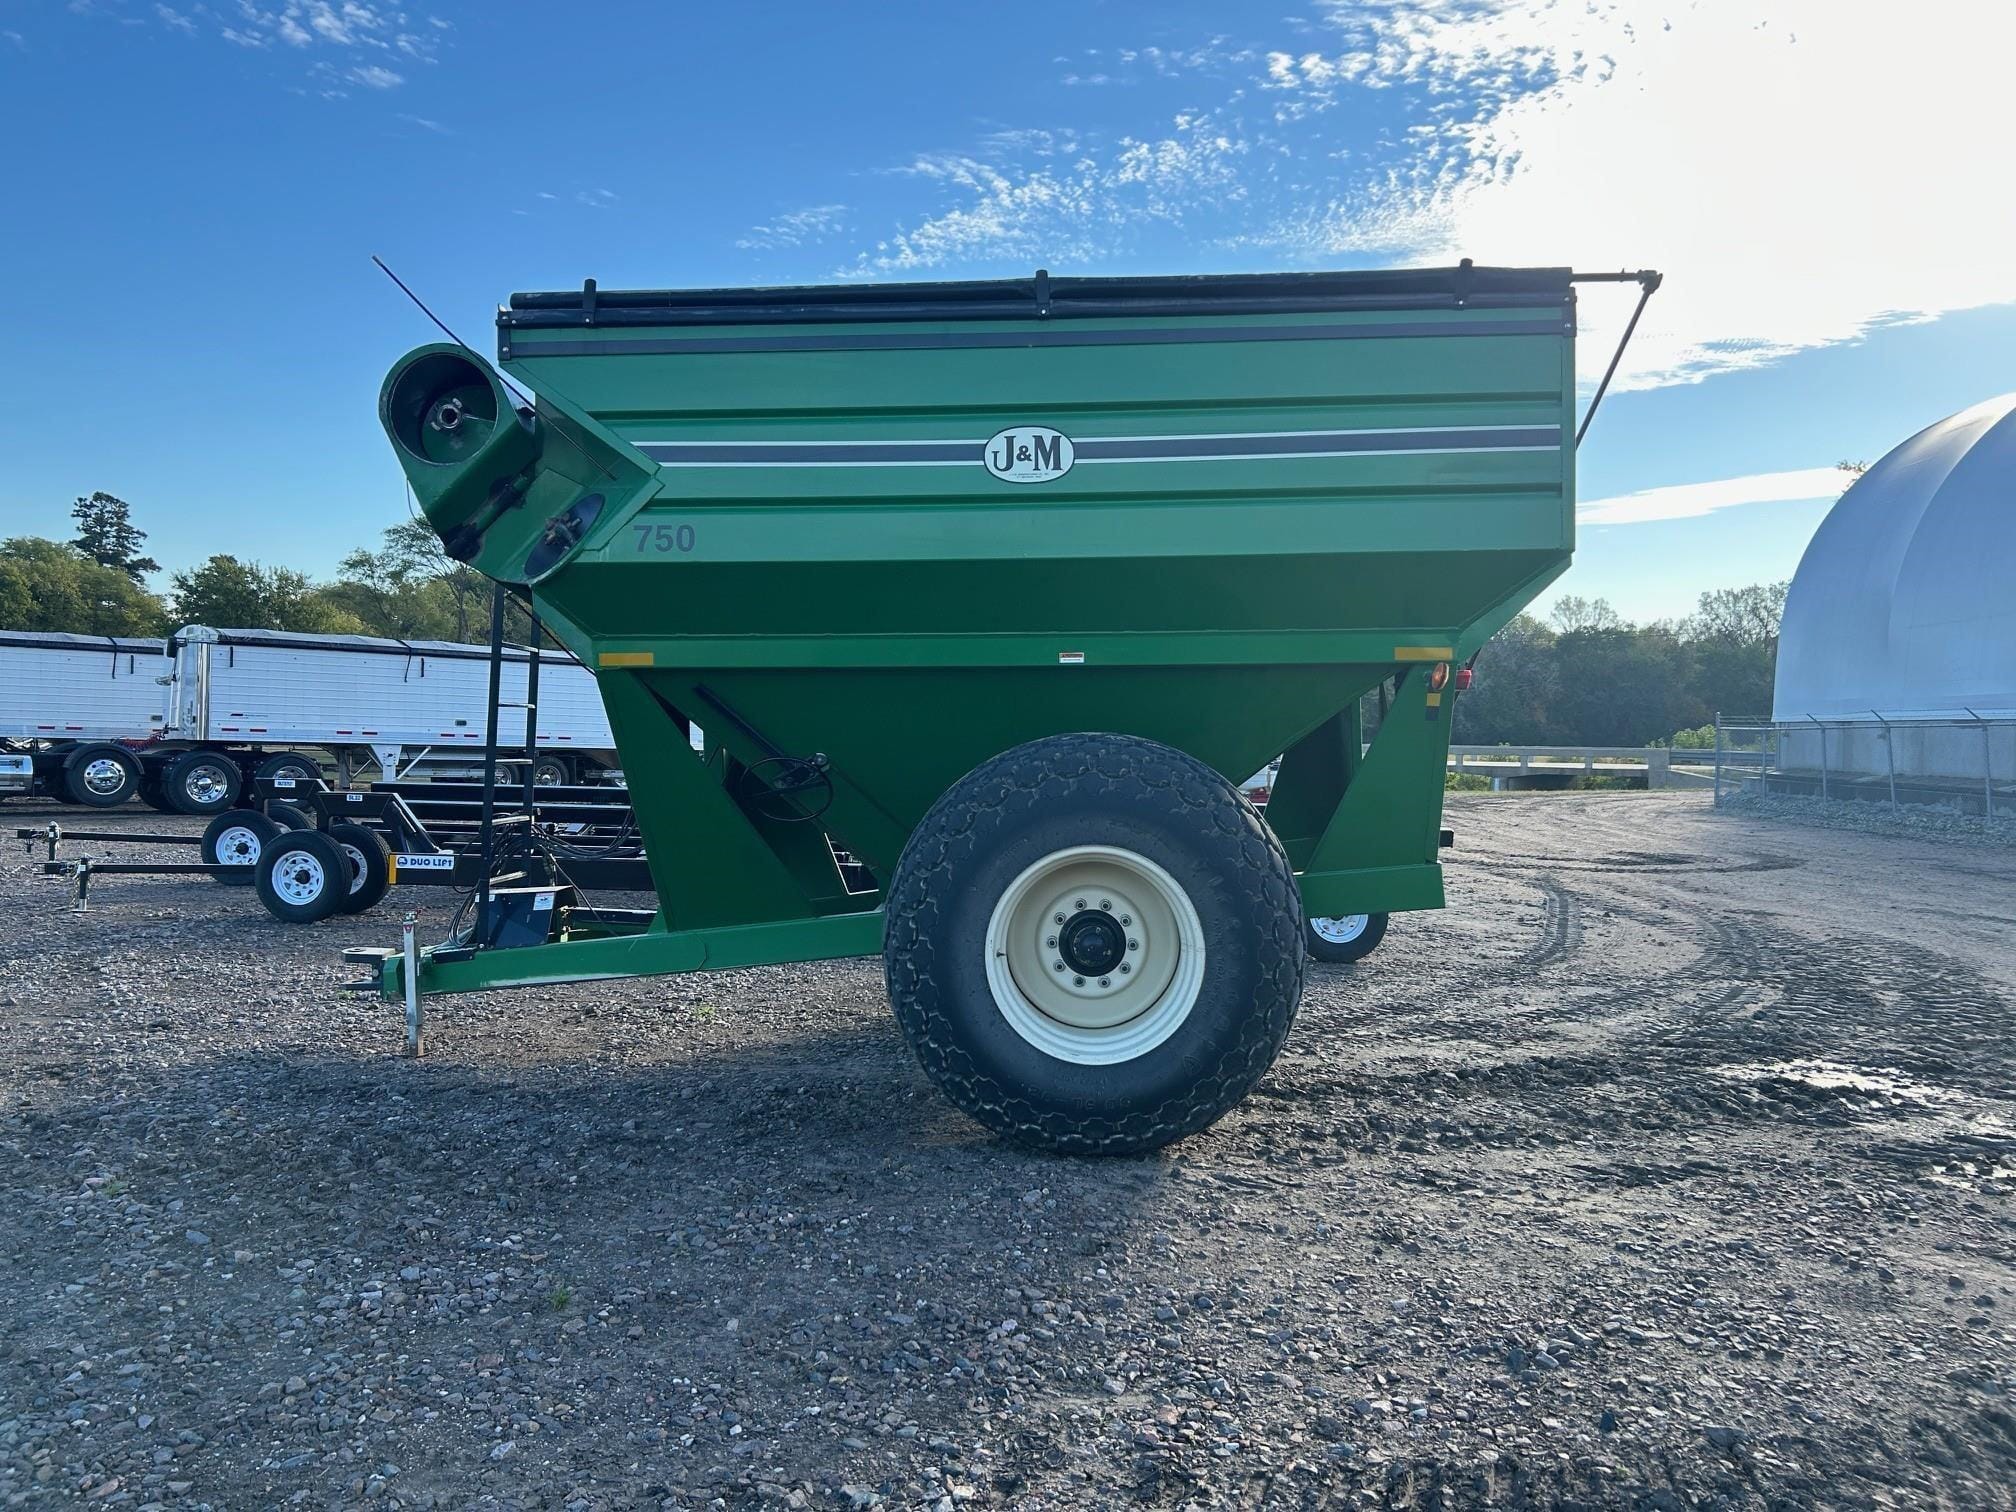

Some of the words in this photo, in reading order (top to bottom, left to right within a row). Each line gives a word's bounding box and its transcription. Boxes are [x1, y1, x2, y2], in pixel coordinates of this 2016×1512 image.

[991, 435, 1064, 472] J&M
[633, 524, 696, 553] 750
[410, 858, 431, 866] DUO
[433, 858, 453, 867] LIFT
